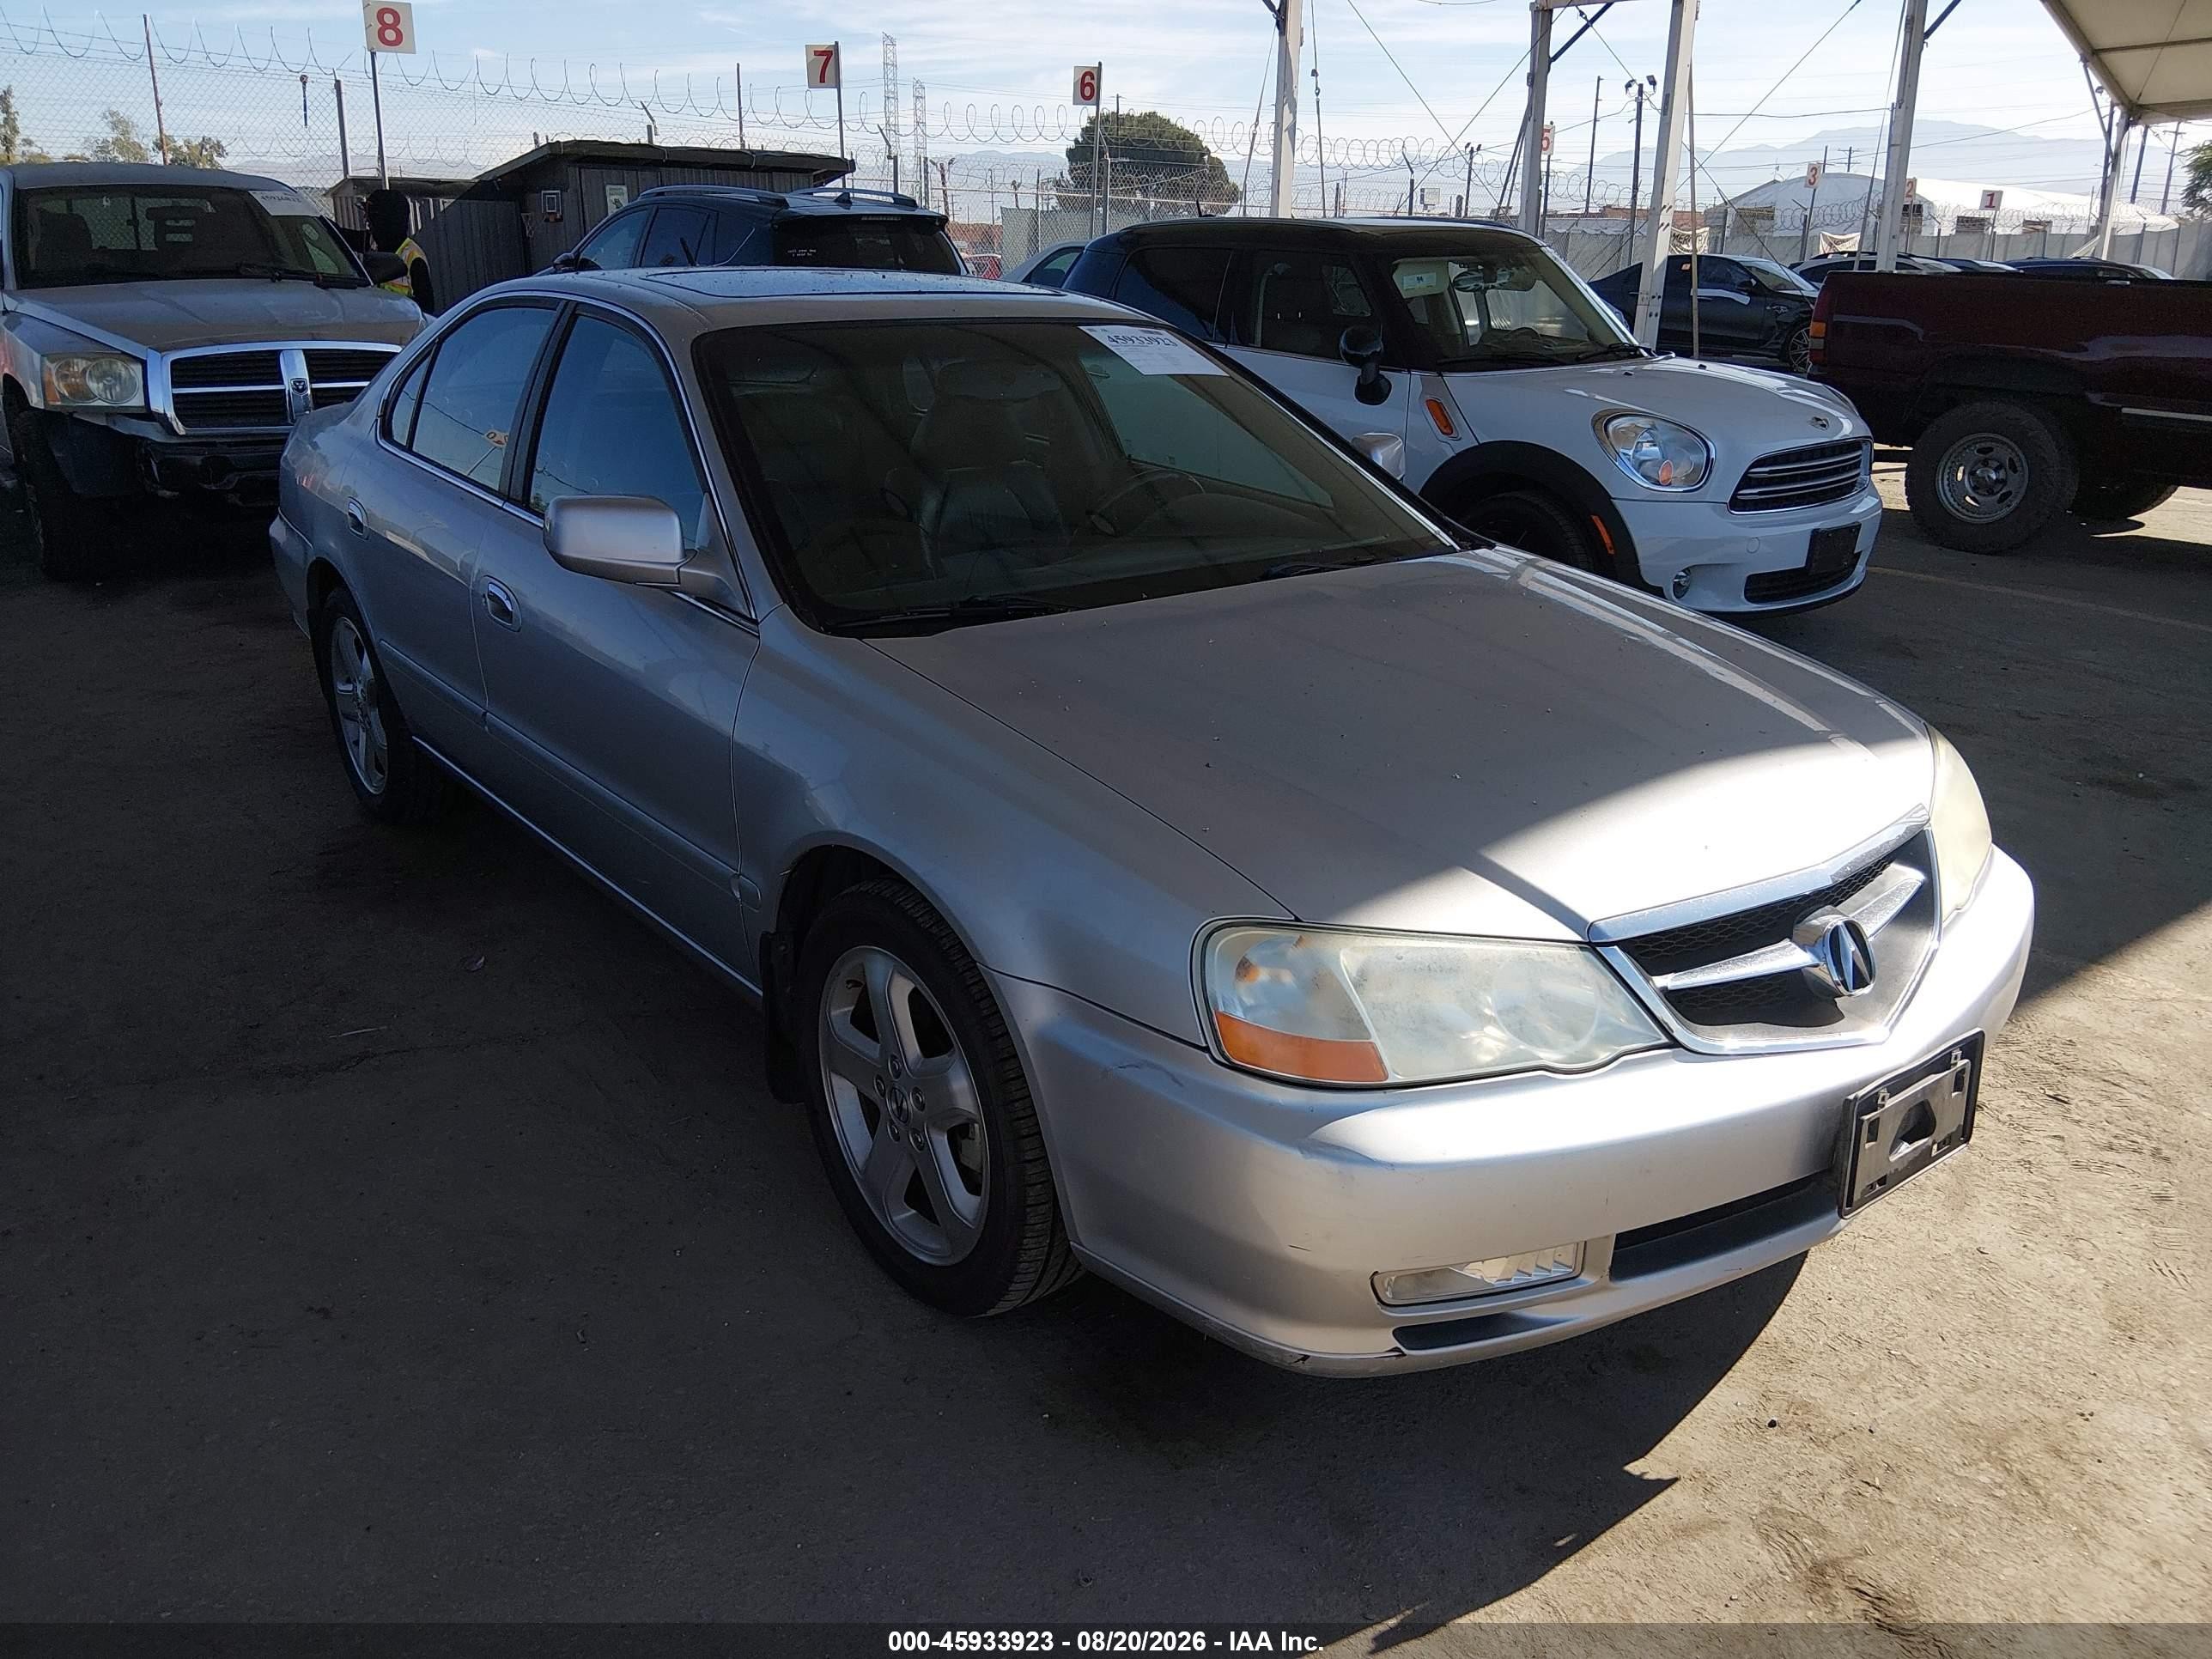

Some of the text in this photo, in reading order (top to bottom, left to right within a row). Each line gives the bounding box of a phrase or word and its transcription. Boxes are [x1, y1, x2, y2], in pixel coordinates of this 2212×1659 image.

[376, 7, 404, 47] 8
[813, 50, 833, 83] 7
[1080, 70, 1095, 101] 6
[1541, 128, 1551, 152] 5
[1808, 167, 1818, 186] 3
[1905, 180, 1914, 198] 2
[1984, 192, 1996, 209] 1
[1107, 335, 1178, 347] 45933923
